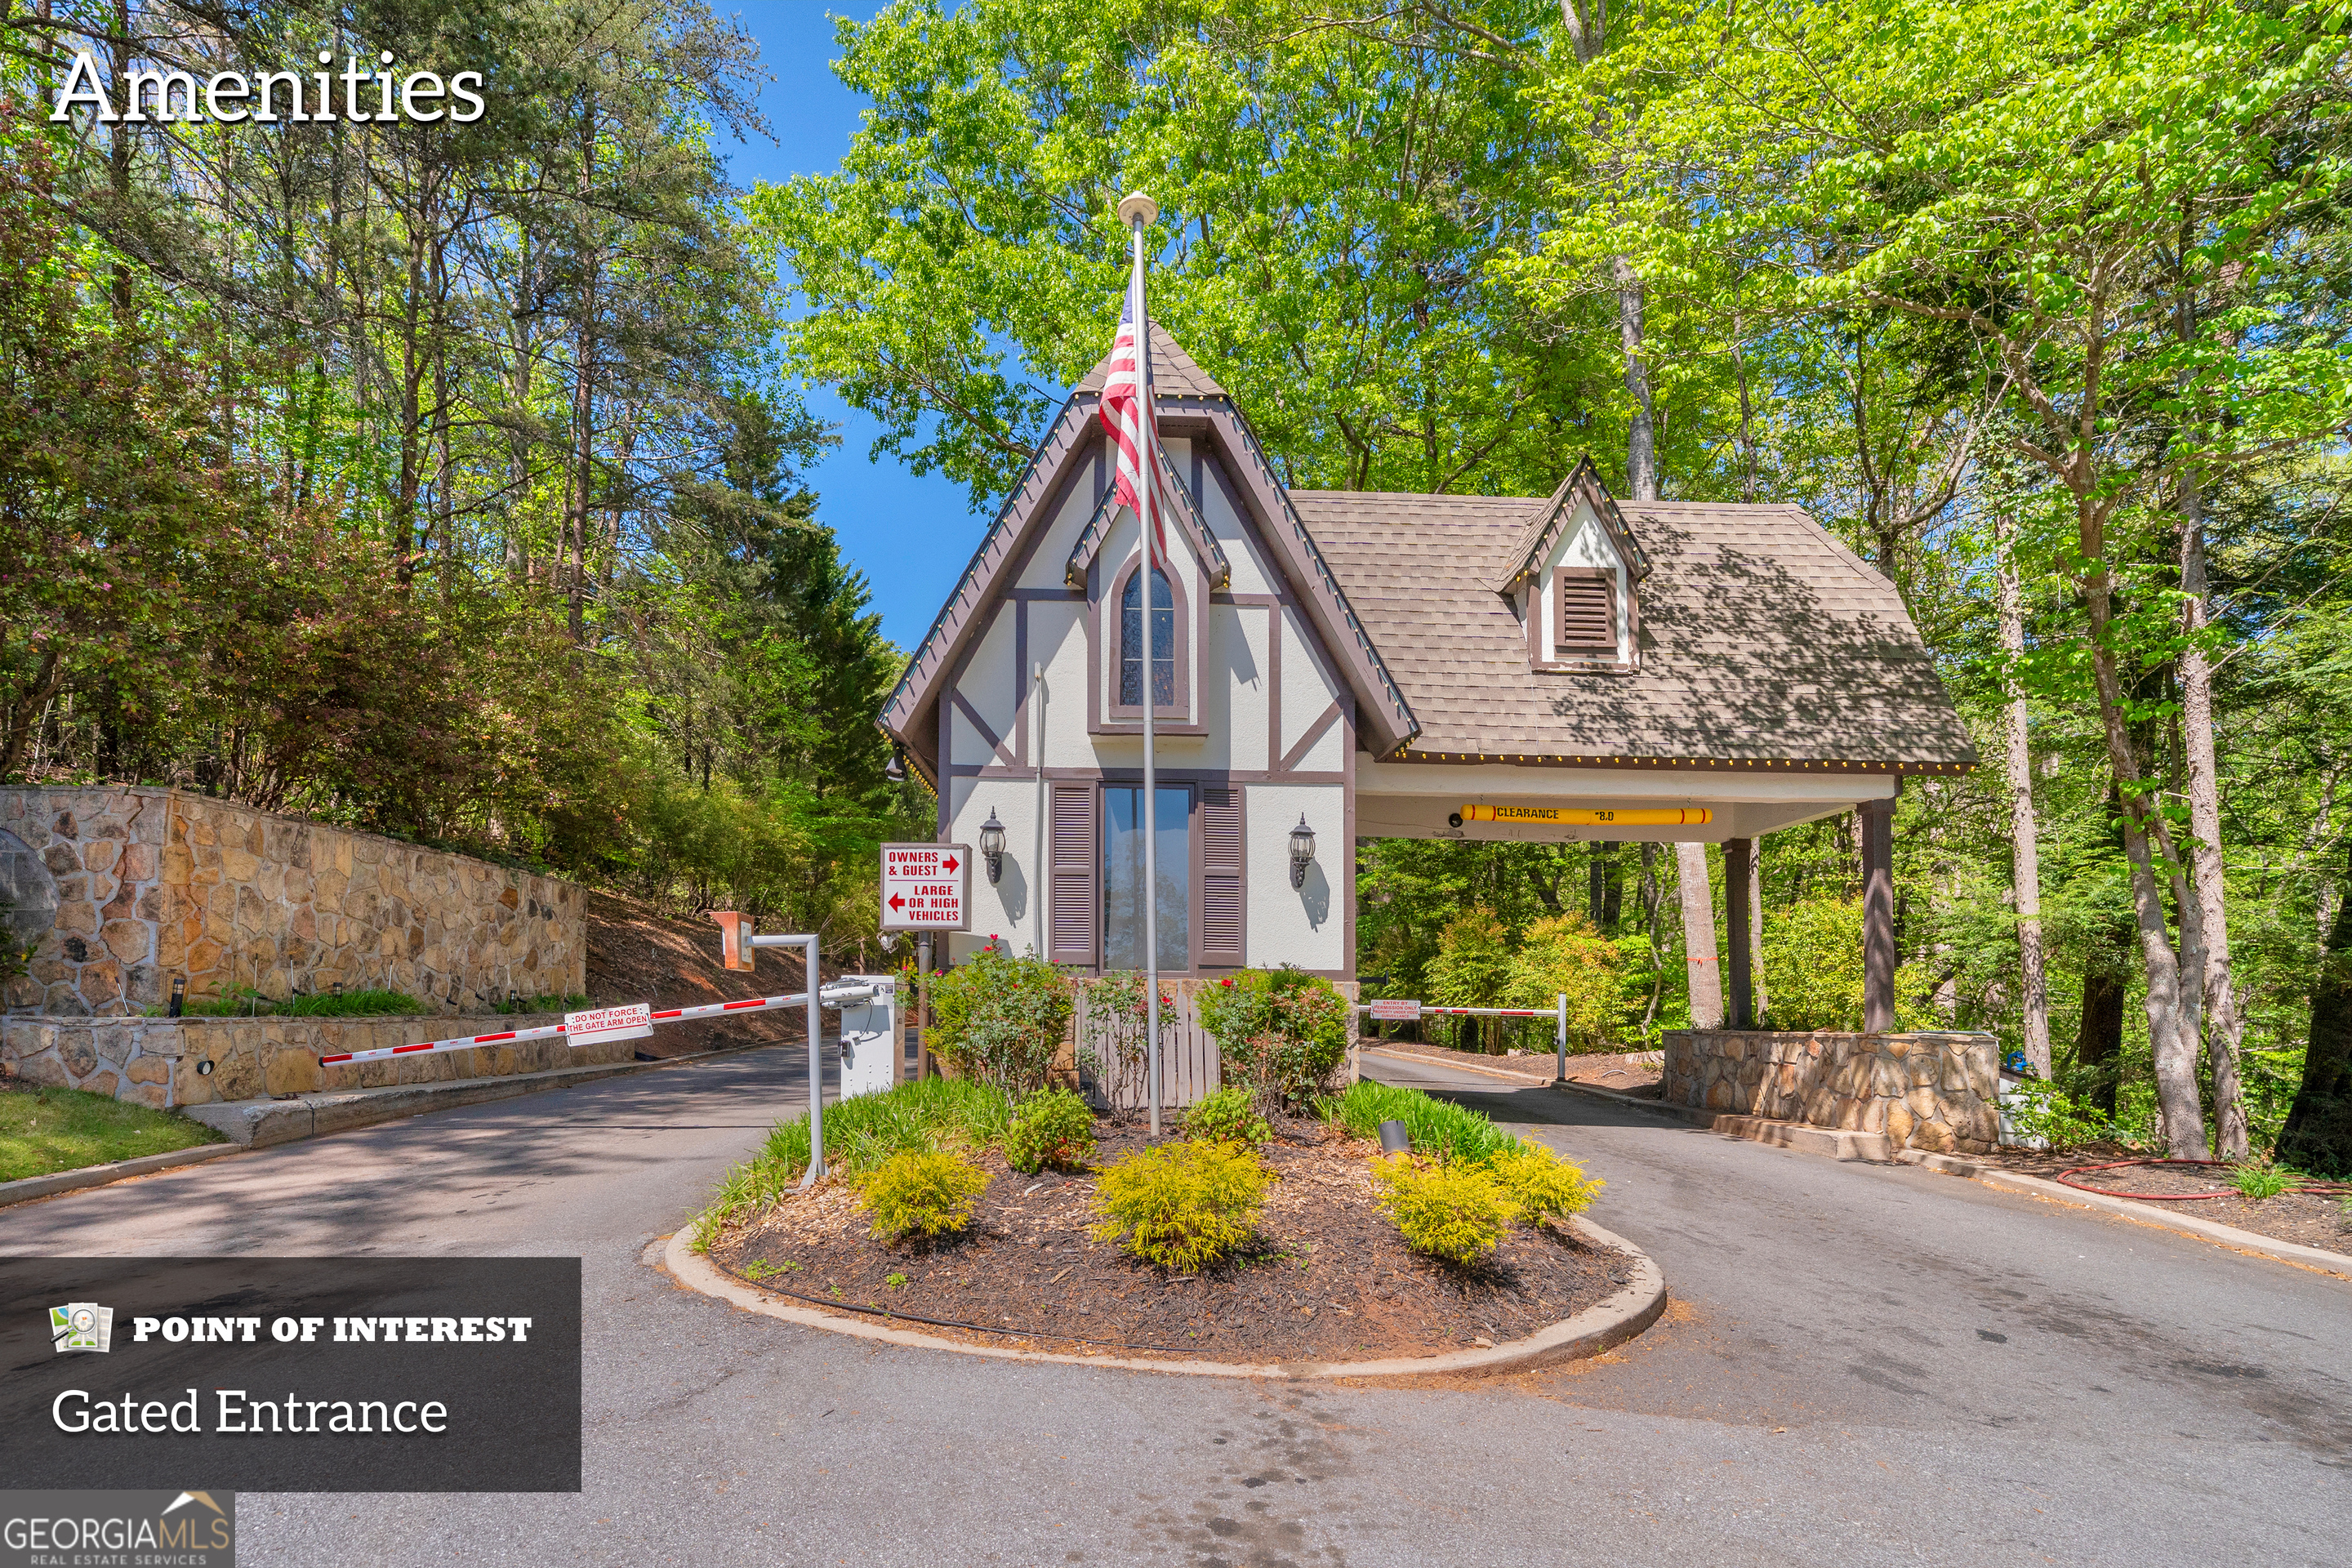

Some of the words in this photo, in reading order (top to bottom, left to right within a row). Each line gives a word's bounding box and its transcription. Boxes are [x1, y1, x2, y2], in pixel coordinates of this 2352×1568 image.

[1497, 807, 1559, 819] CLEARANCE
[889, 852, 938, 862] OWNERS
[889, 866, 898, 875] &
[902, 866, 938, 875] GUEST
[915, 885, 953, 895] LARGE
[909, 898, 924, 908] OR
[931, 898, 958, 908] HIGH
[909, 911, 958, 920] VEHICLES
[575, 1014, 587, 1022] DO
[589, 1012, 606, 1020] NOT
[608, 1007, 638, 1018] FORCE
[569, 1023, 583, 1032] THE
[585, 1021, 605, 1030] GATE
[607, 1018, 624, 1027] ARM
[626, 1015, 647, 1024] OPEN
